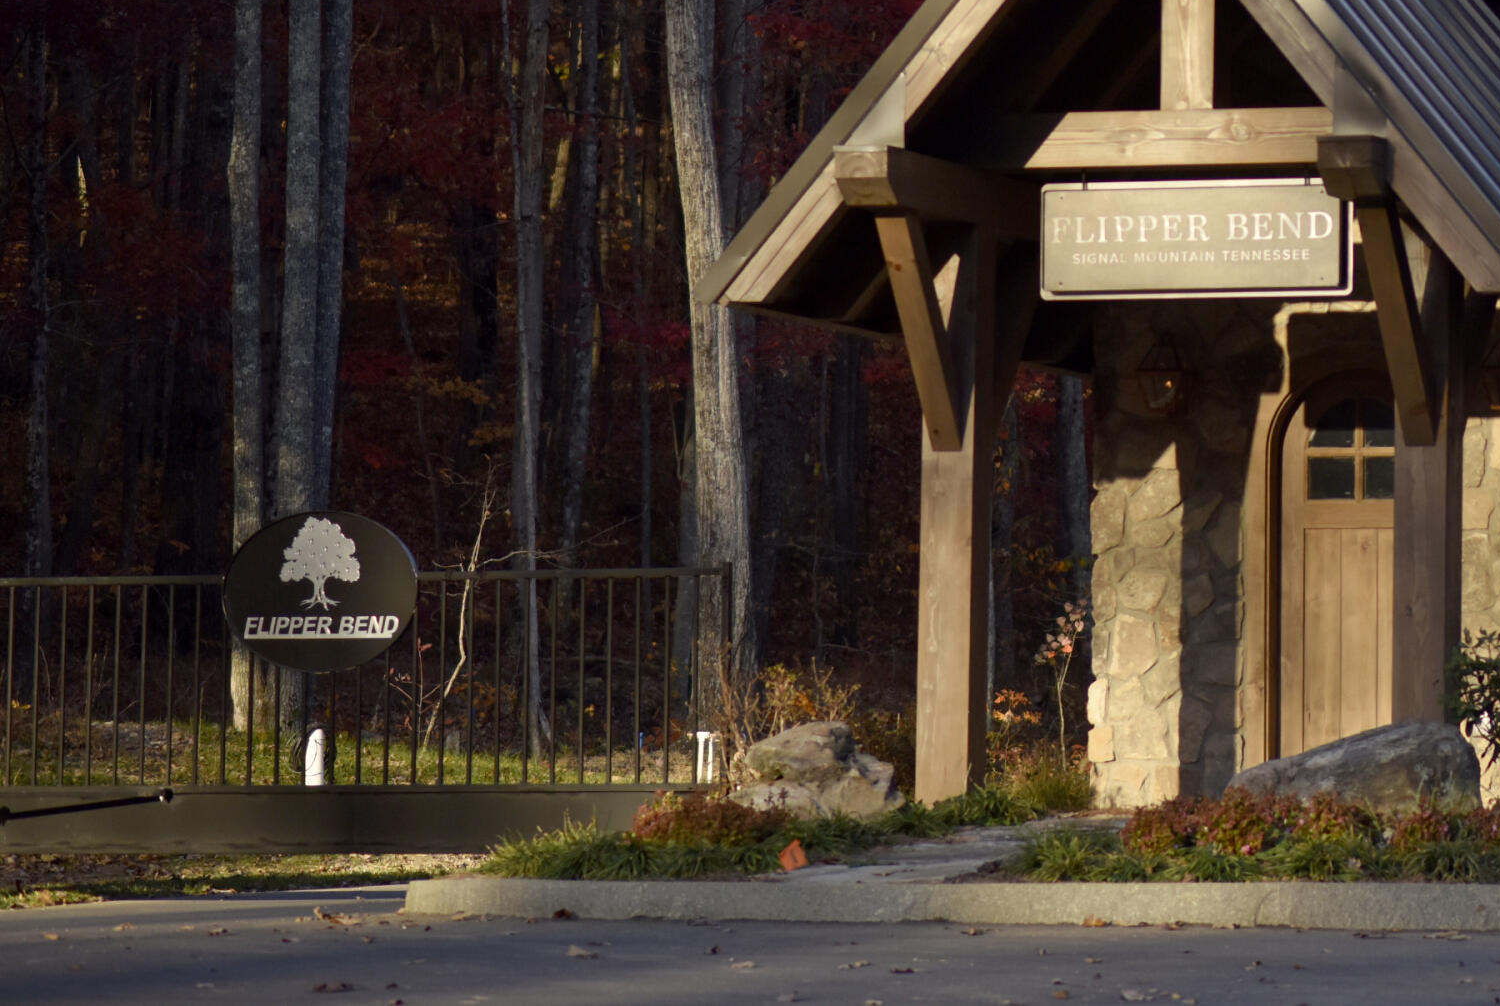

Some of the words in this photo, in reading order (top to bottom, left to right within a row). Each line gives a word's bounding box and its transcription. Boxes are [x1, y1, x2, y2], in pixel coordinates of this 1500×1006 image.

[1051, 213, 1210, 244] FLIPPER
[1226, 211, 1334, 241] BEND
[1072, 252, 1127, 265] SIGNAL
[1133, 251, 1215, 264] MOUNTAIN
[1222, 249, 1311, 262] TENNESSEE
[244, 616, 333, 638] FLIPPER
[338, 615, 400, 637] BEND
